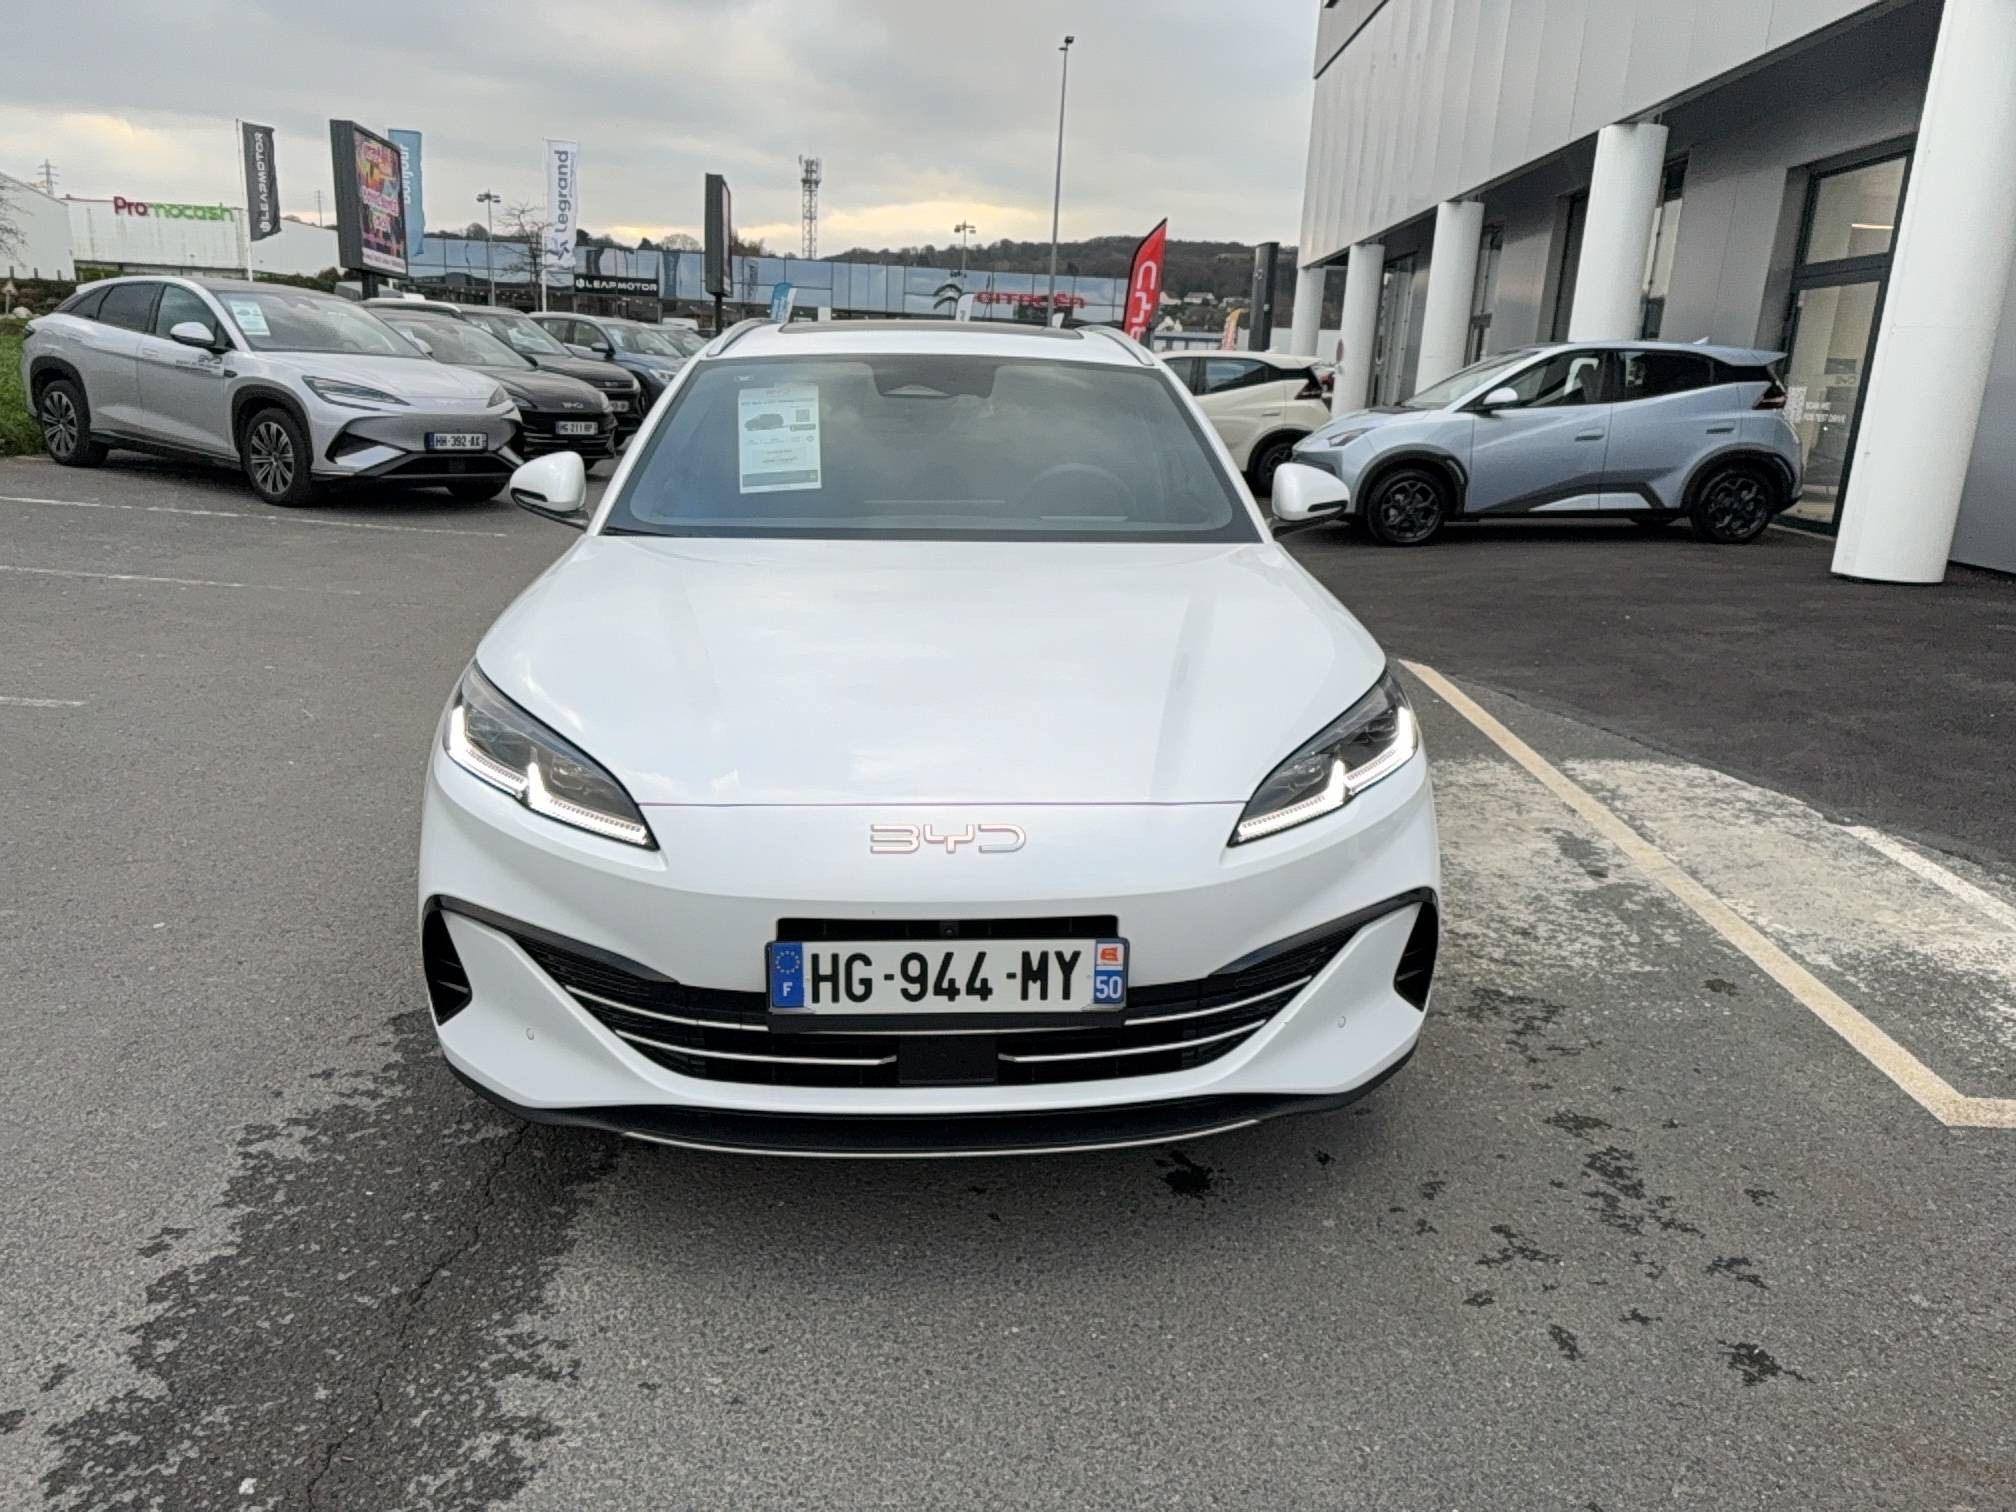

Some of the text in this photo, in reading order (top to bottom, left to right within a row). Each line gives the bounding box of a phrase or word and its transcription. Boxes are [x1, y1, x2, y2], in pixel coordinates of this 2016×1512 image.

[870, 823, 1027, 854] BYD
[782, 981, 793, 997] F
[810, 950, 1082, 1004] HG-944-MY
[1096, 975, 1122, 1000] 50
